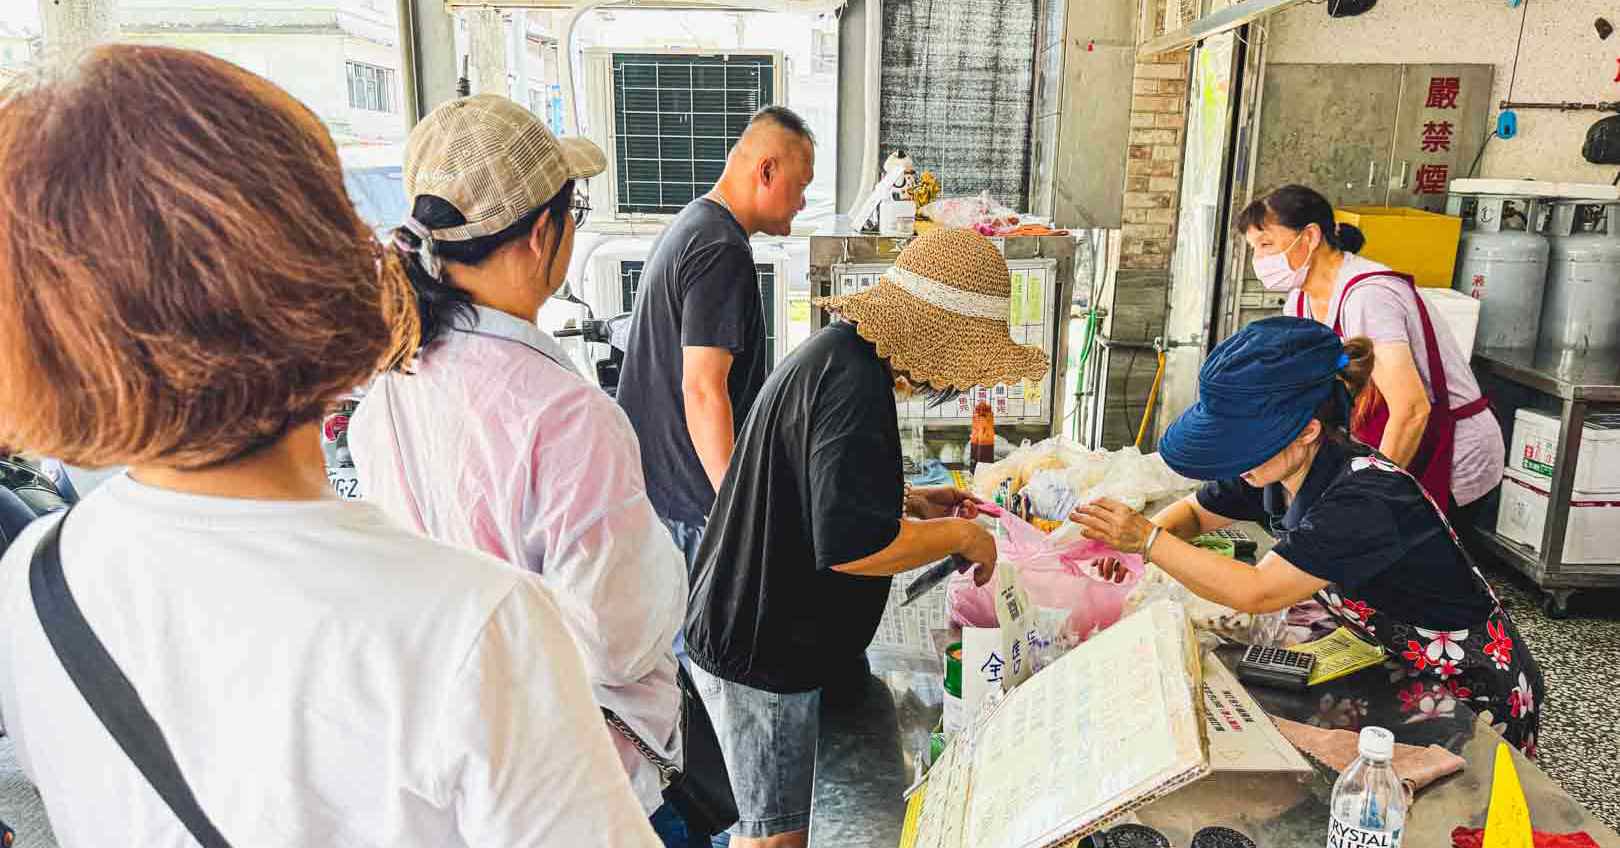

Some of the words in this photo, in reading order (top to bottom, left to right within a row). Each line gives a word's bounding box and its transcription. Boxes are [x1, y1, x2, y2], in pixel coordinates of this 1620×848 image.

[1414, 77, 1460, 195] 嚴禁煙
[1330, 819, 1389, 847] RYSTAL
